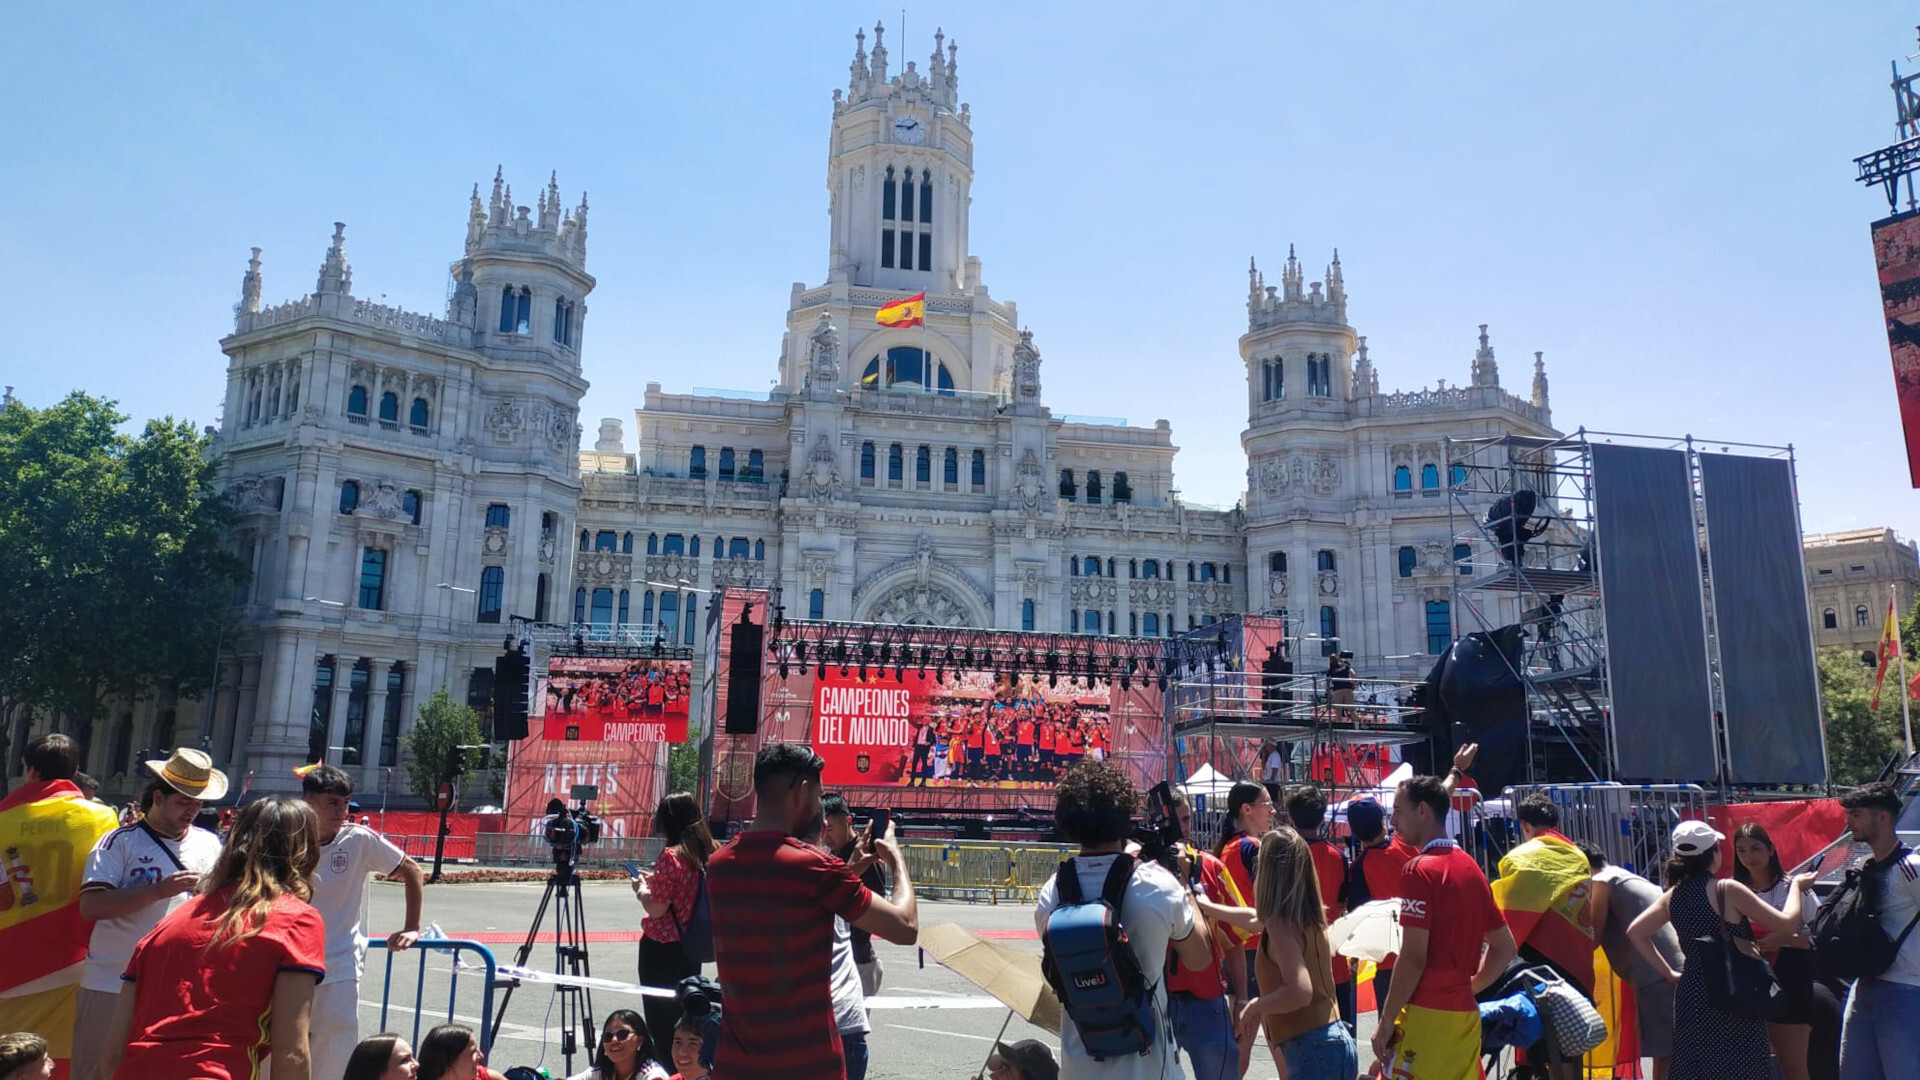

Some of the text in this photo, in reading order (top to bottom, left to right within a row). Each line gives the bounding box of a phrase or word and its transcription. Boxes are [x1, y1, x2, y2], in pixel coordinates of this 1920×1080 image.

[820, 687, 910, 717] CAMPEONES
[604, 722, 666, 742] CAMPEONES
[819, 716, 909, 746] DEL MUNDO
[1074, 973, 1106, 988] LiveU
